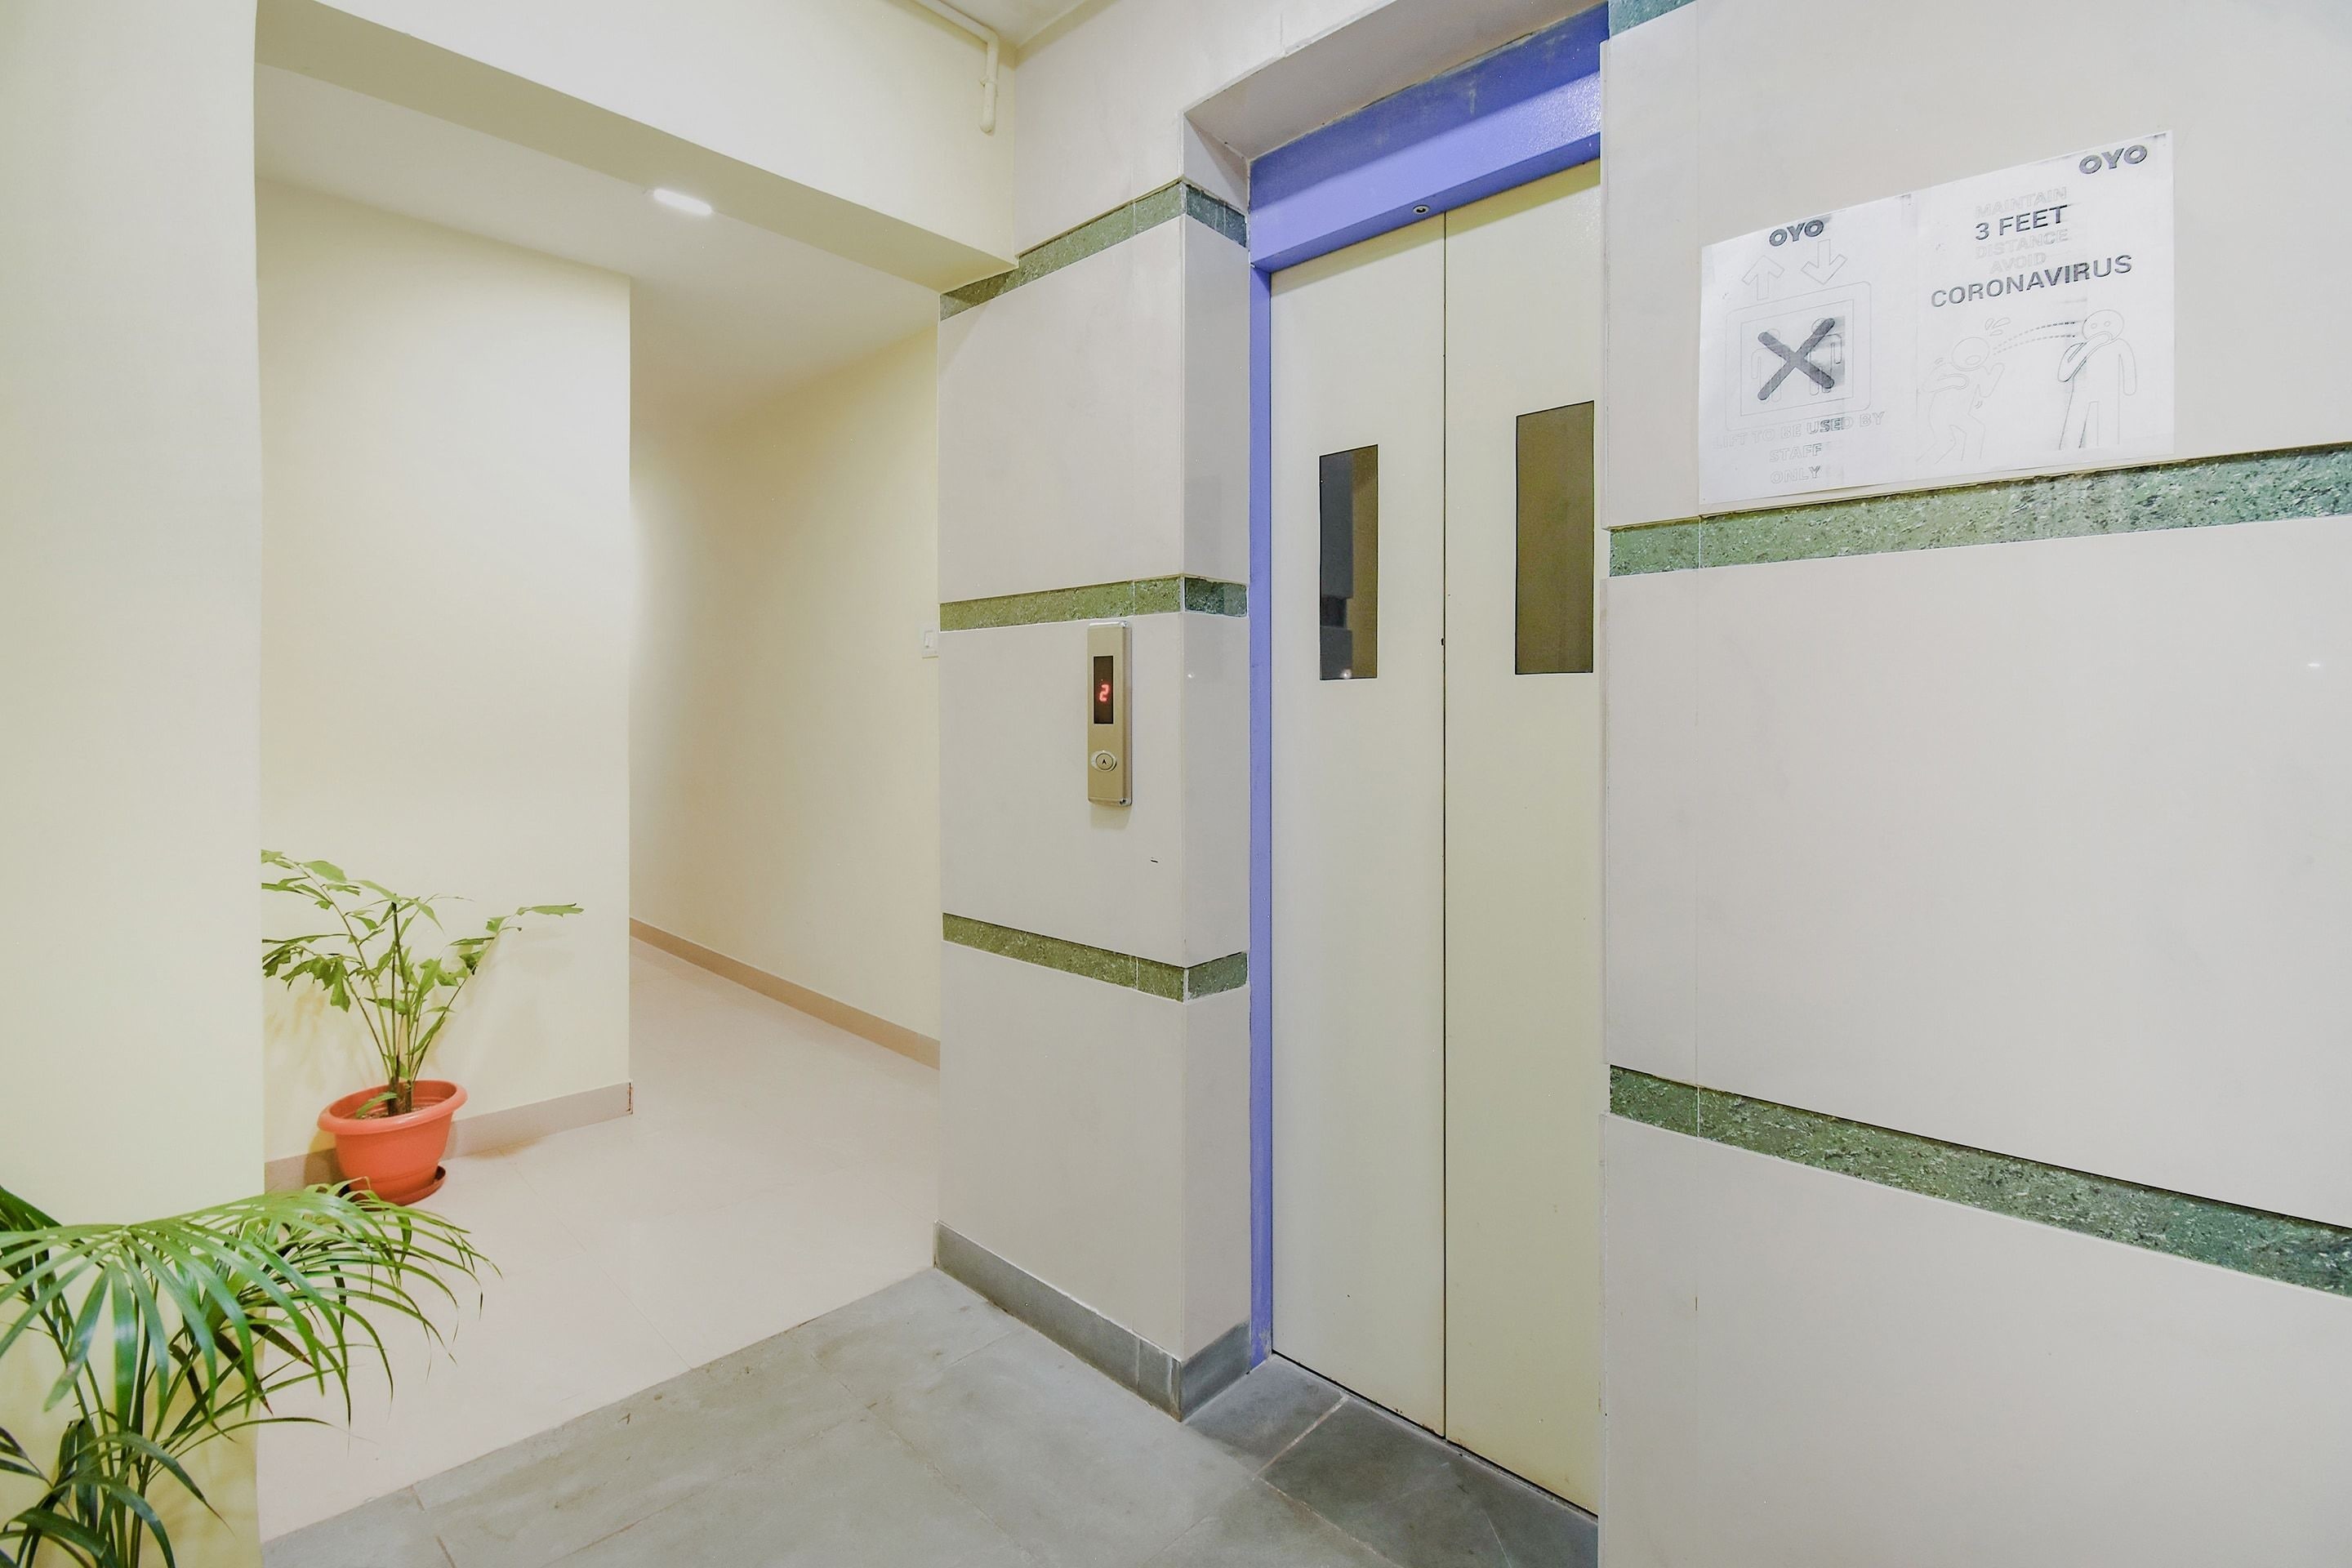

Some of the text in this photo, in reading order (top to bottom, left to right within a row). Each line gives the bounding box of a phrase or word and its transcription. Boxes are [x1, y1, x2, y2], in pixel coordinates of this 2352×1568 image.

[2079, 145, 2148, 174] OYO
[1976, 187, 2067, 218] MAINTAIN
[1769, 220, 1824, 247] OYO
[1975, 204, 2069, 240] 3 FEET
[1976, 229, 2069, 259] DISTANCE
[1990, 252, 2047, 274] AVOID
[1931, 255, 2132, 308] CORONAVIRUS
[1713, 412, 1886, 449] LIFT TO BE USED BY
[1769, 443, 1823, 463] STAFF
[1770, 466, 1821, 483] ONLY
[1098, 684, 1111, 702] 2
